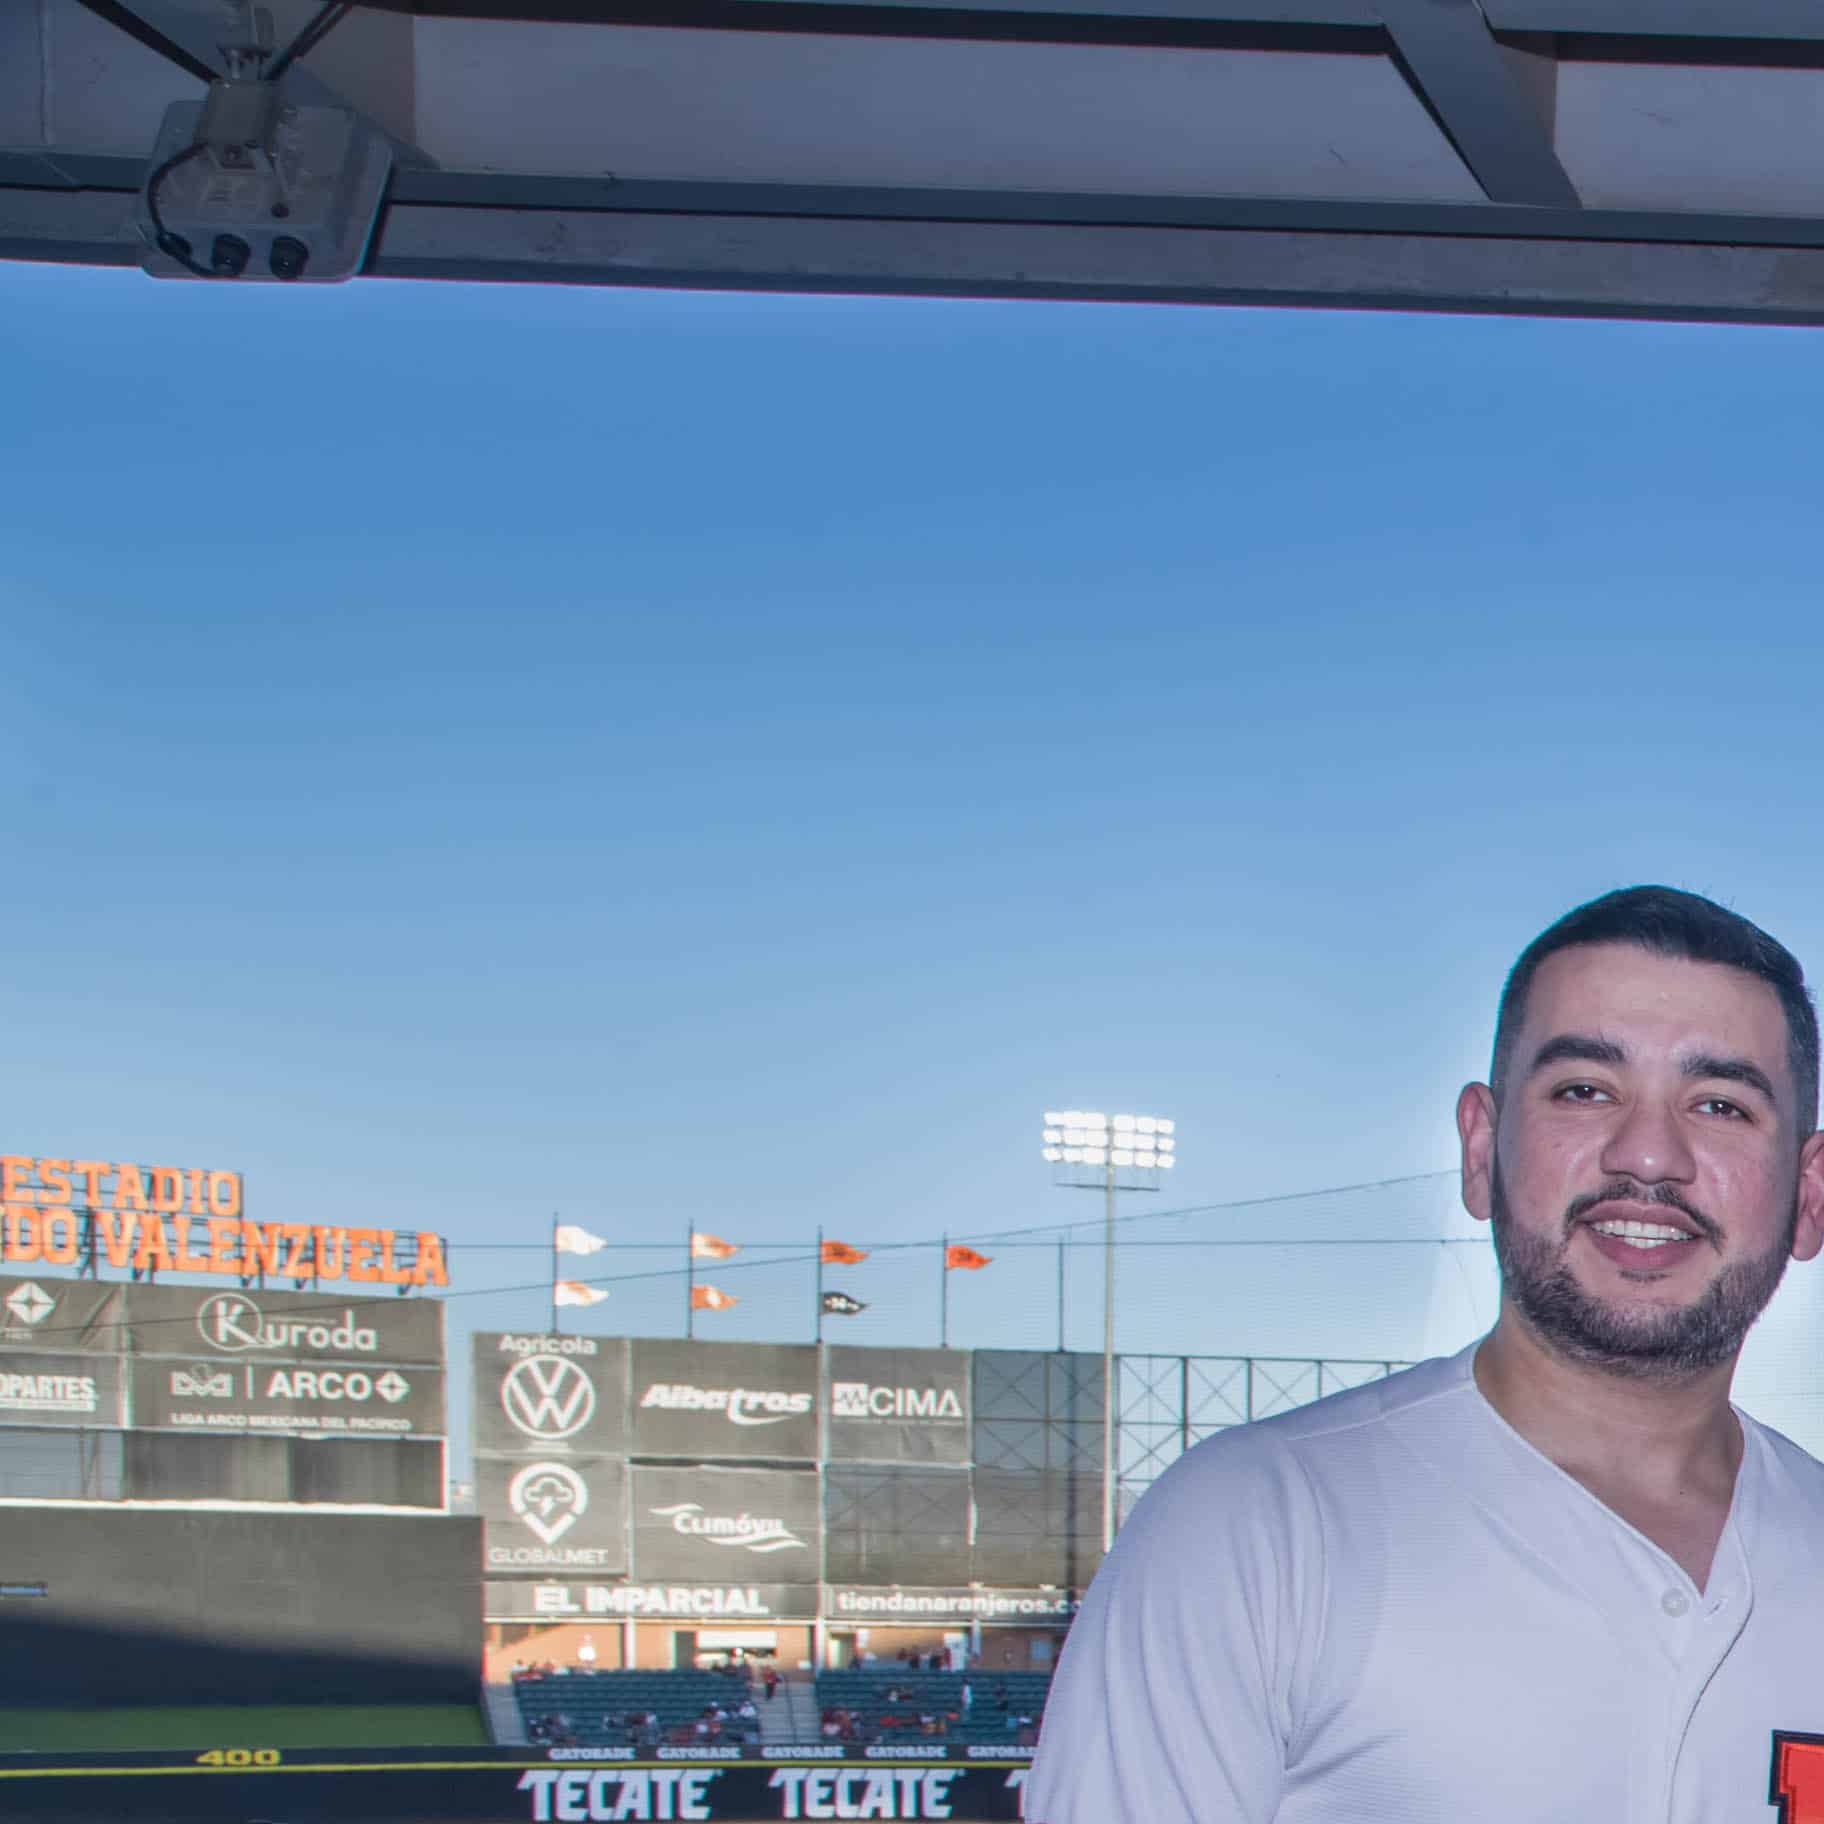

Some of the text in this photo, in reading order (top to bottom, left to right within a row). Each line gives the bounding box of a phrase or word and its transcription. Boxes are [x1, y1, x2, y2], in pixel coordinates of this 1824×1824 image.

[0, 1155, 241, 1217] ESTADIO
[0, 1204, 449, 1286] DO VALENZUELA
[202, 1294, 378, 1351] Kuroda
[267, 1371, 372, 1400] ARCO
[869, 1388, 963, 1417] CIMA
[641, 1384, 812, 1425] Albatros
[489, 1547, 609, 1566] GLOBALMET
[533, 1587, 769, 1615] EL IMPARCIAL
[196, 1749, 281, 1766] 400
[518, 1768, 724, 1822] TECATE
[769, 1767, 966, 1818] TECATE
